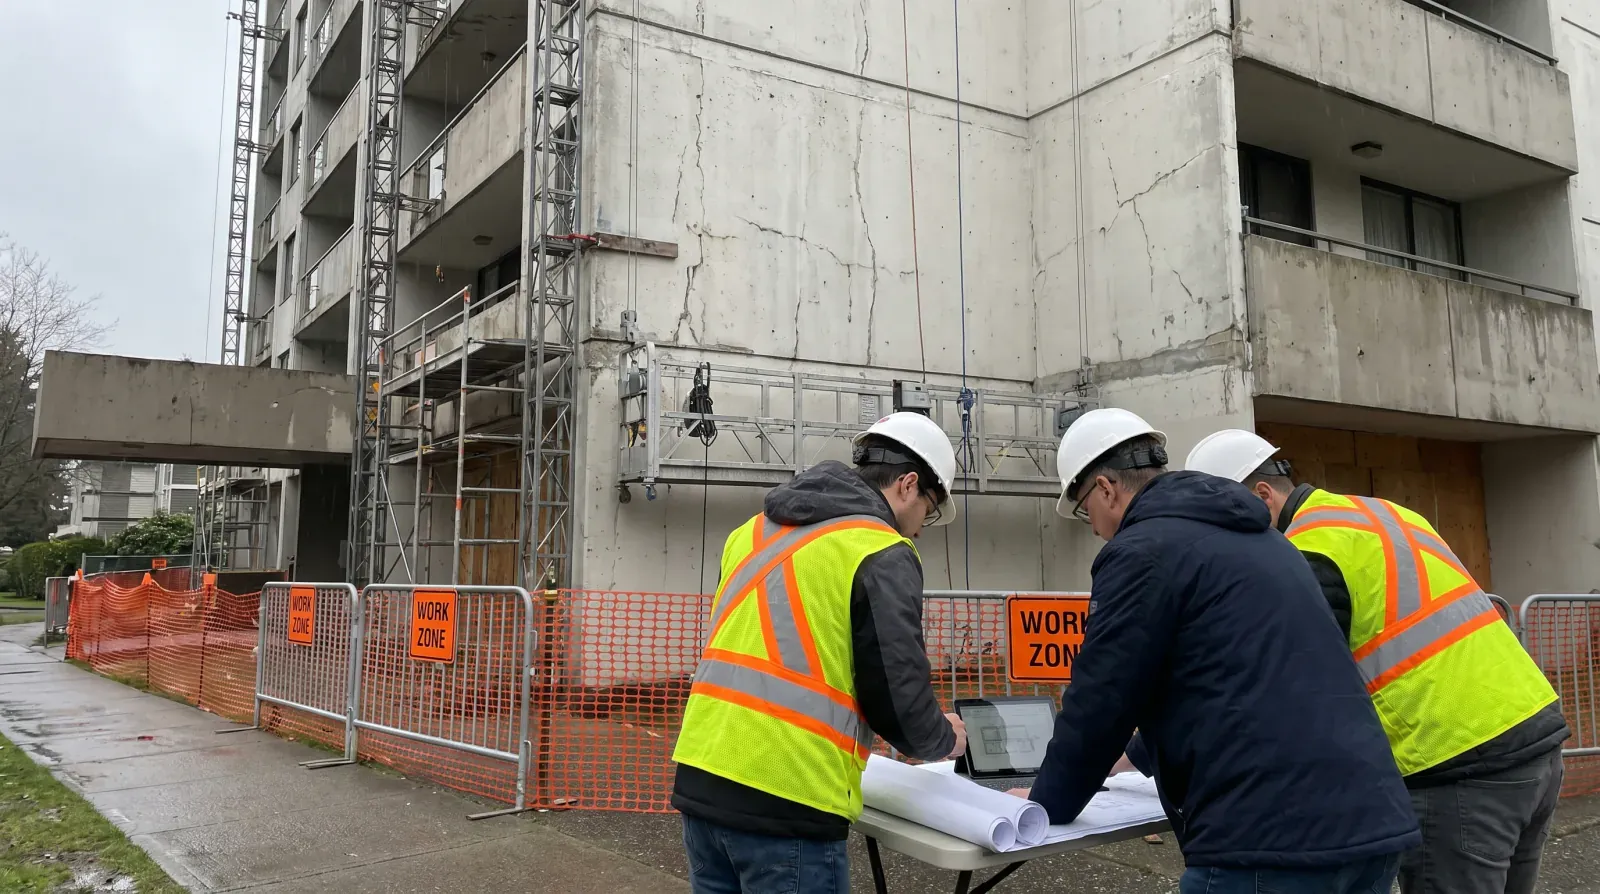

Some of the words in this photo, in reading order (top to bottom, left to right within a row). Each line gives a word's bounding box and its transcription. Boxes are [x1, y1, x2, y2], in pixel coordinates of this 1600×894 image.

[293, 596, 312, 612] WORK
[417, 601, 449, 621] WORK
[292, 617, 309, 634] ZONE
[417, 627, 446, 648] ZONE
[1029, 643, 1082, 667] ZON
